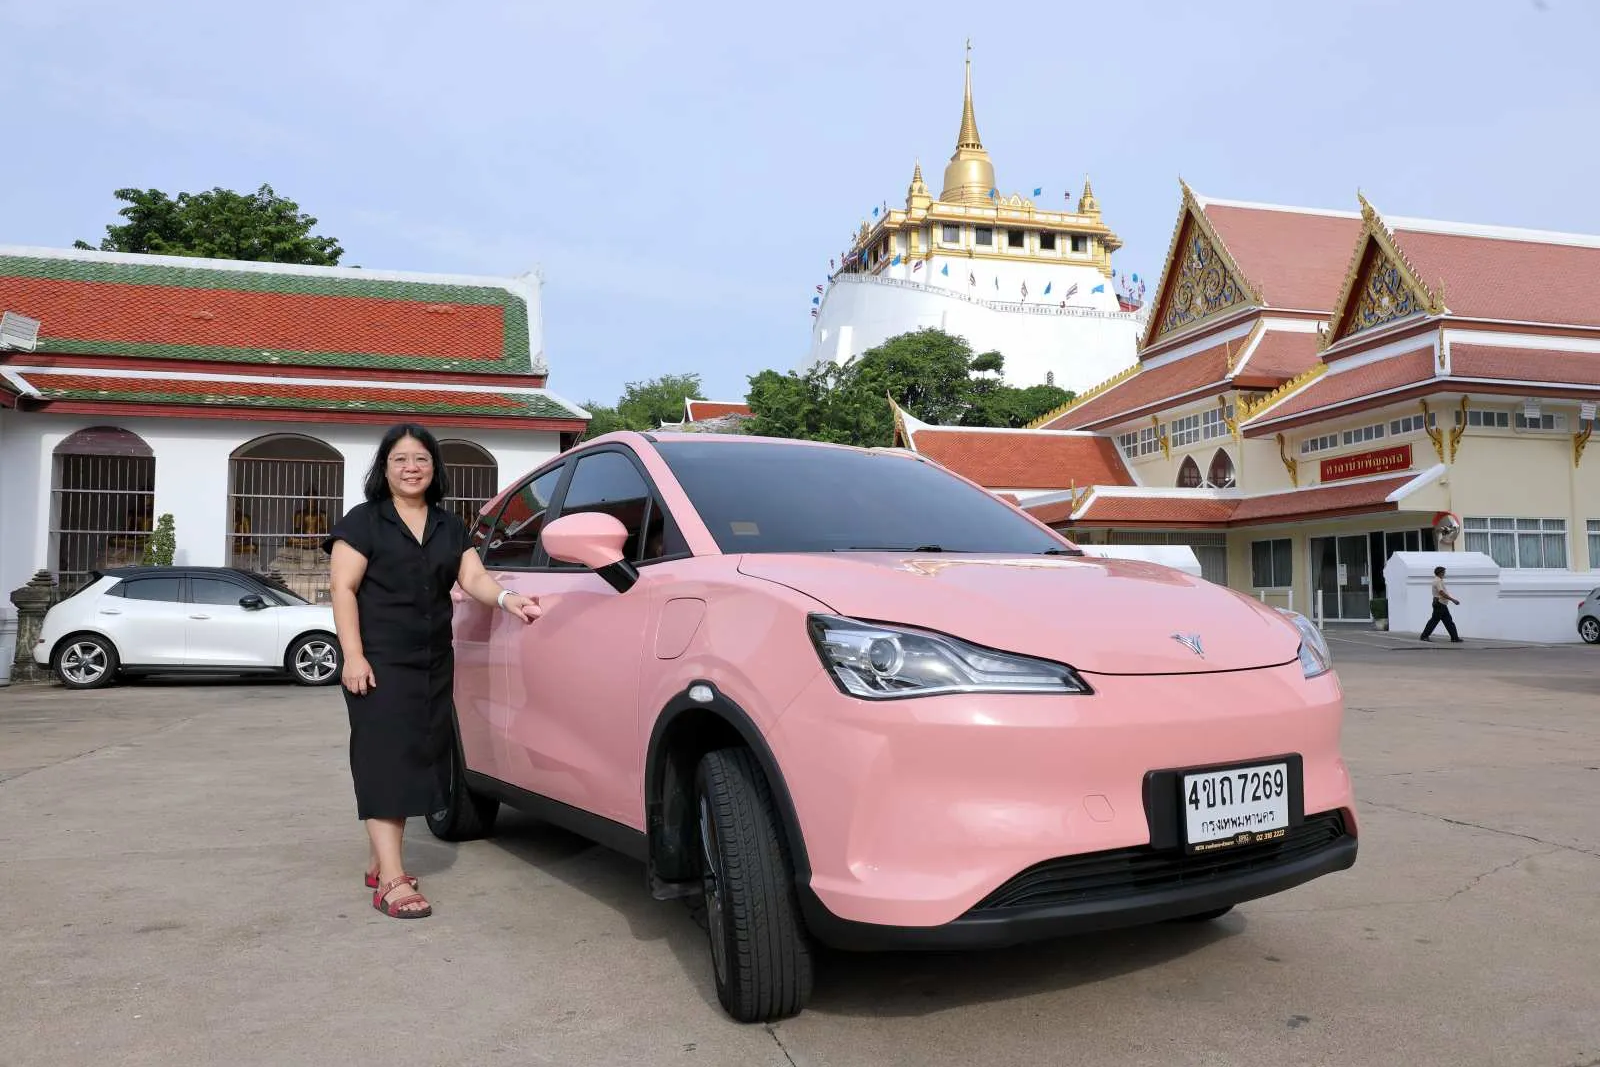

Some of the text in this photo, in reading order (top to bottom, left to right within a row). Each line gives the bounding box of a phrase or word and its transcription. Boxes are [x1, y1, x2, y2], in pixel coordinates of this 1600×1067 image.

[1326, 453, 1403, 475] ศาลาบำเพ็ญกุศล
[1238, 769, 1284, 804] 7269
[1202, 810, 1275, 835] กรุงเทพมหานคร
